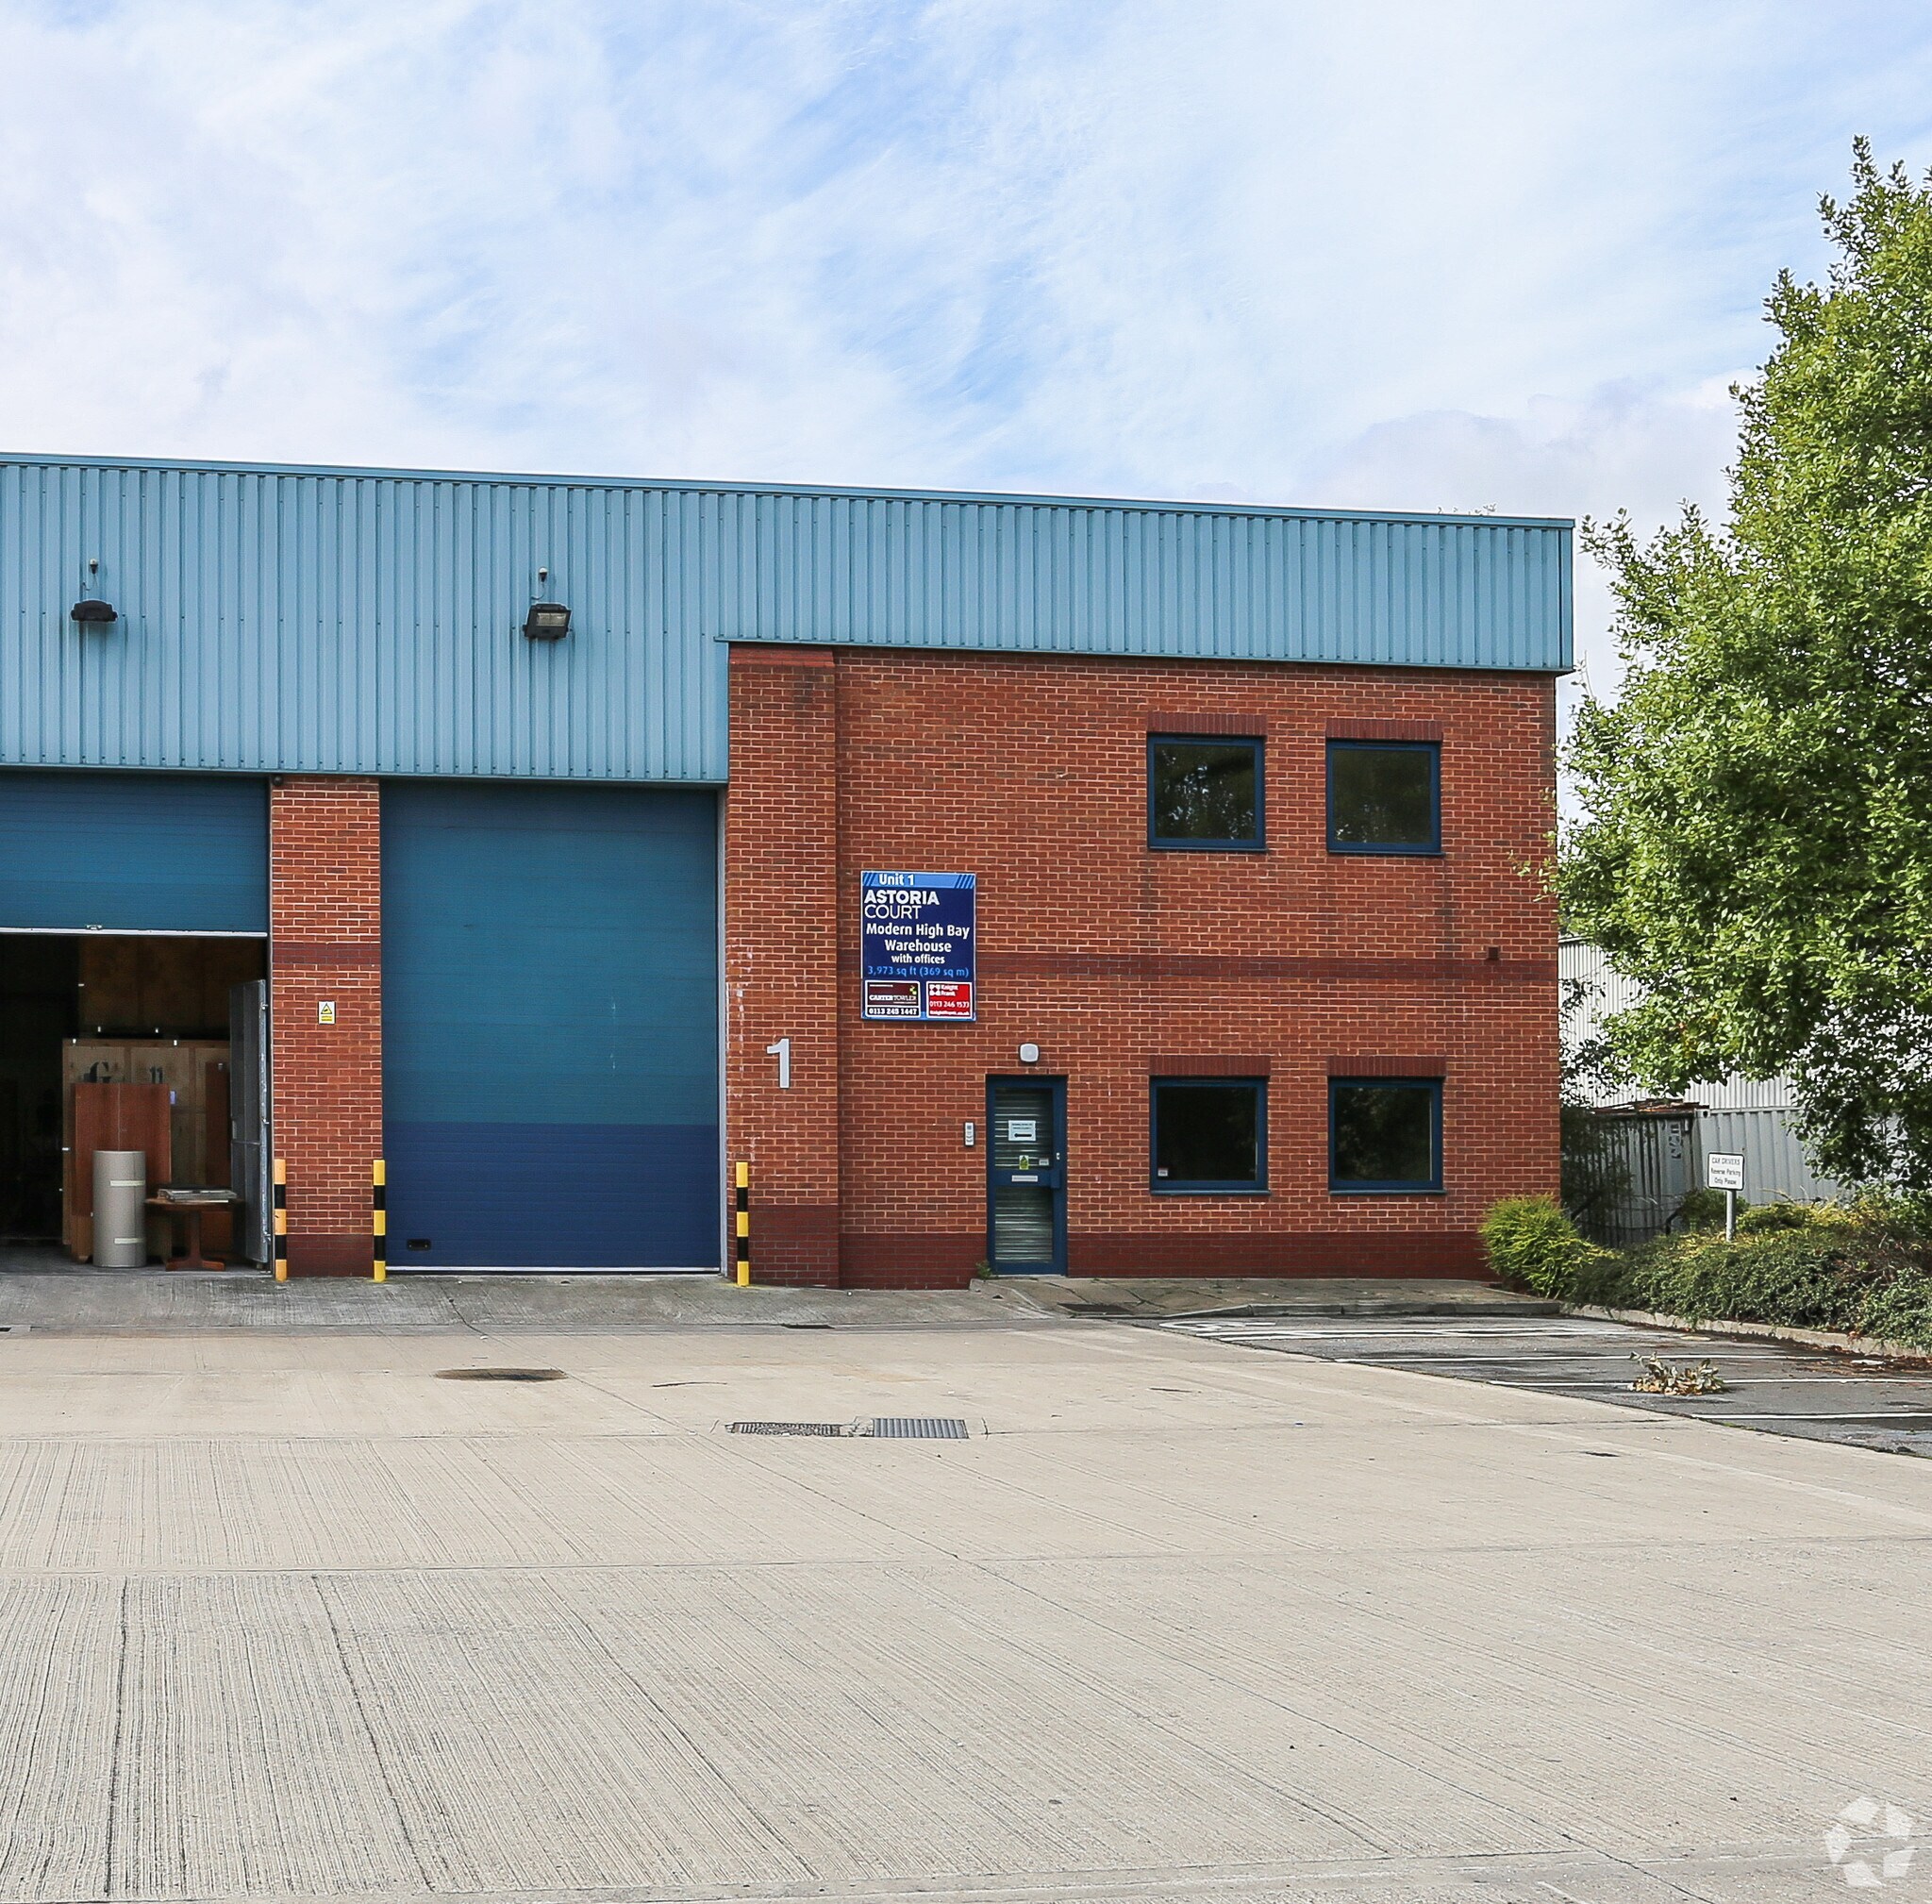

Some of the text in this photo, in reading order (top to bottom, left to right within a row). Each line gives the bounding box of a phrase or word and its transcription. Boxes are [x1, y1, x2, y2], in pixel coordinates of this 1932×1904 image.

[879, 873, 914, 885] Unit 1
[864, 890, 940, 905] ASTORIA
[864, 905, 922, 919] COURT
[866, 923, 970, 939] Modern High Bay
[884, 939, 952, 952] Warehouse
[891, 954, 945, 963] with offices
[868, 966, 970, 977] 3,973 sq ft (369 sq m)
[766, 1038, 790, 1089] 1
